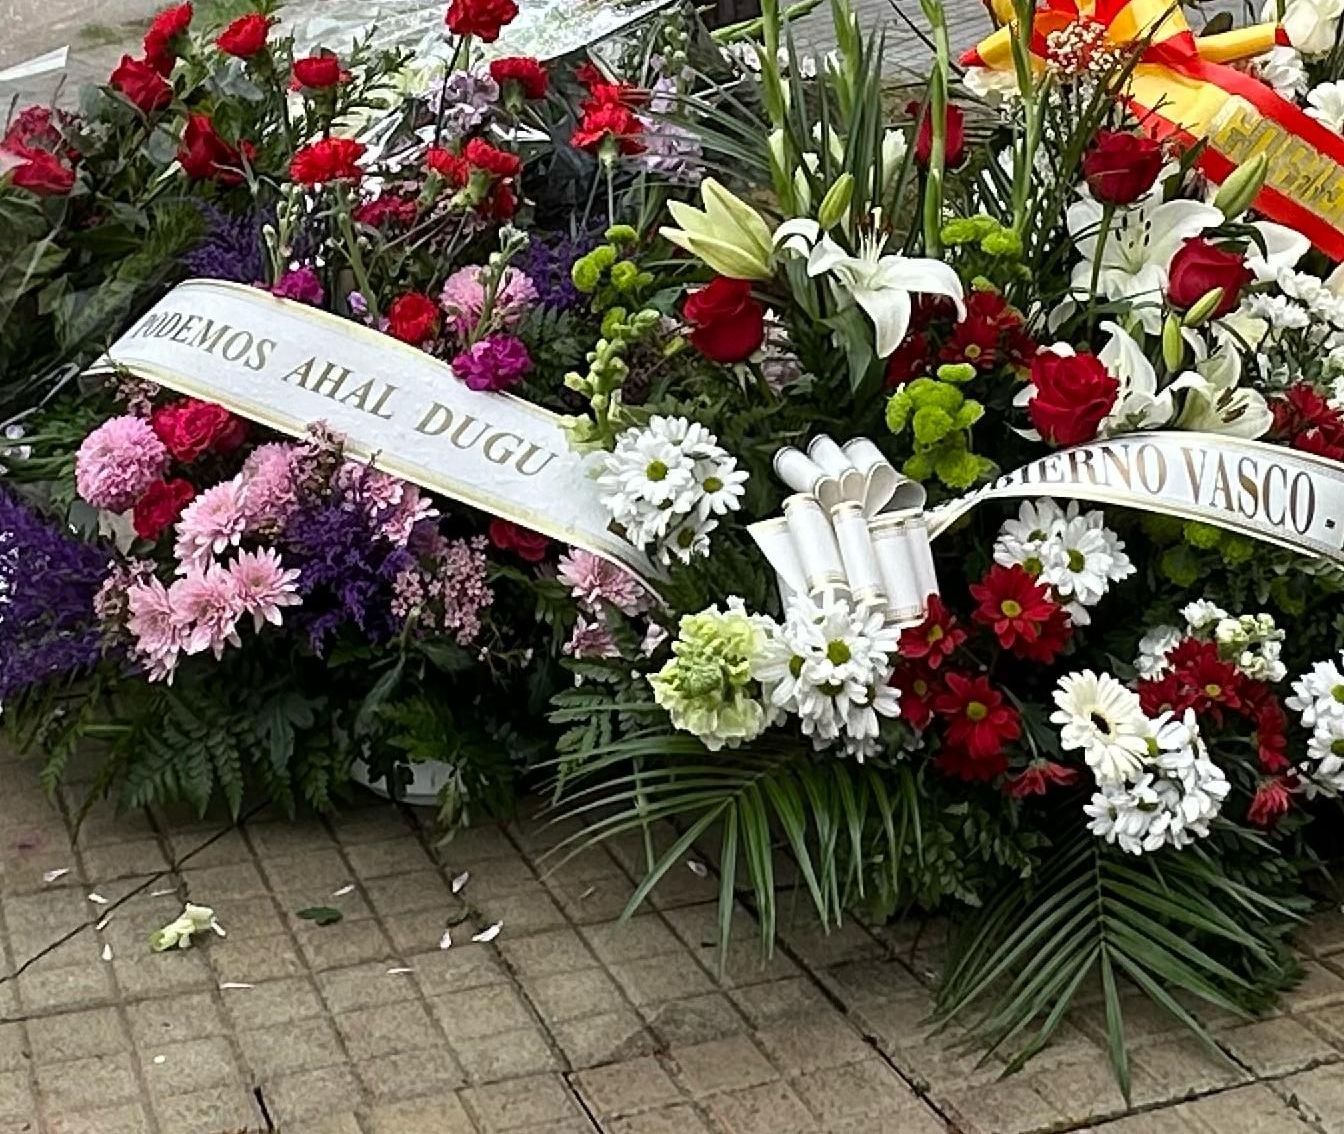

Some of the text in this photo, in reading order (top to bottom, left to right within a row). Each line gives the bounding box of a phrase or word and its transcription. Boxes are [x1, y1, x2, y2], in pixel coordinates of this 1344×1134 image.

[131, 307, 560, 478] PODEMOS AHAL DUGU
[1180, 444, 1318, 536] VASCO
